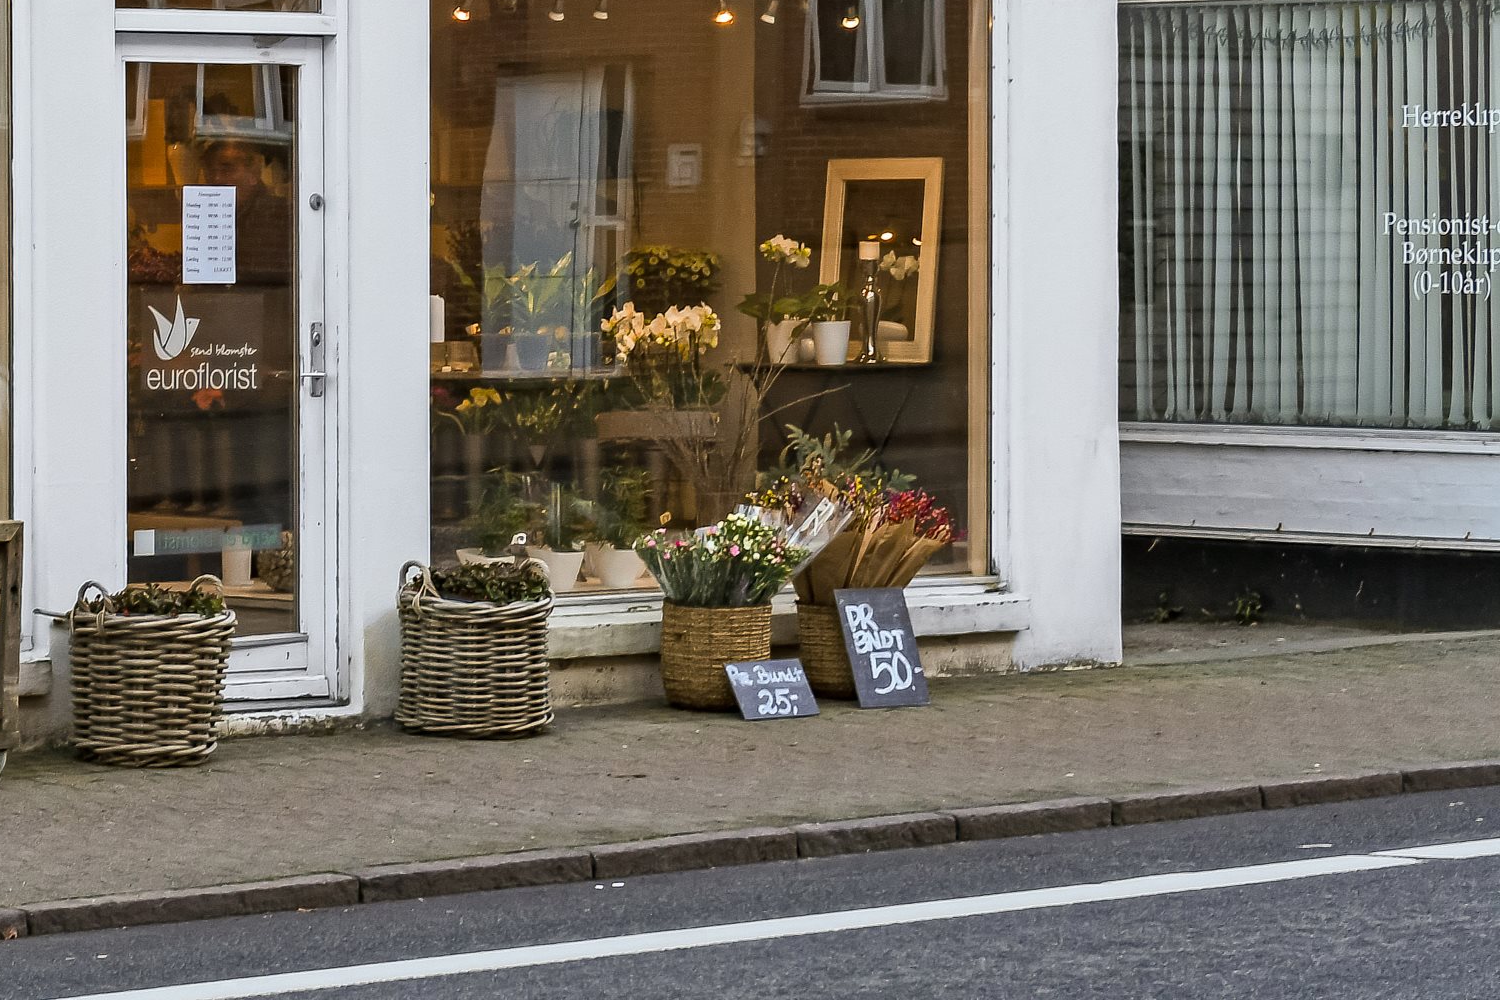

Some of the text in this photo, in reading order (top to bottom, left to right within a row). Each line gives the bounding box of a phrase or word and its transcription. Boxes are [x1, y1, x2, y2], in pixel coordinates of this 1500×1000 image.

[1401, 102, 1500, 134] Herreklip
[1401, 241, 1500, 273] Børneklip
[1413, 270, 1491, 301] (0-10år)
[190, 342, 258, 358] send blomster
[146, 362, 258, 390] euroflorist
[752, 664, 803, 684] Bundt
